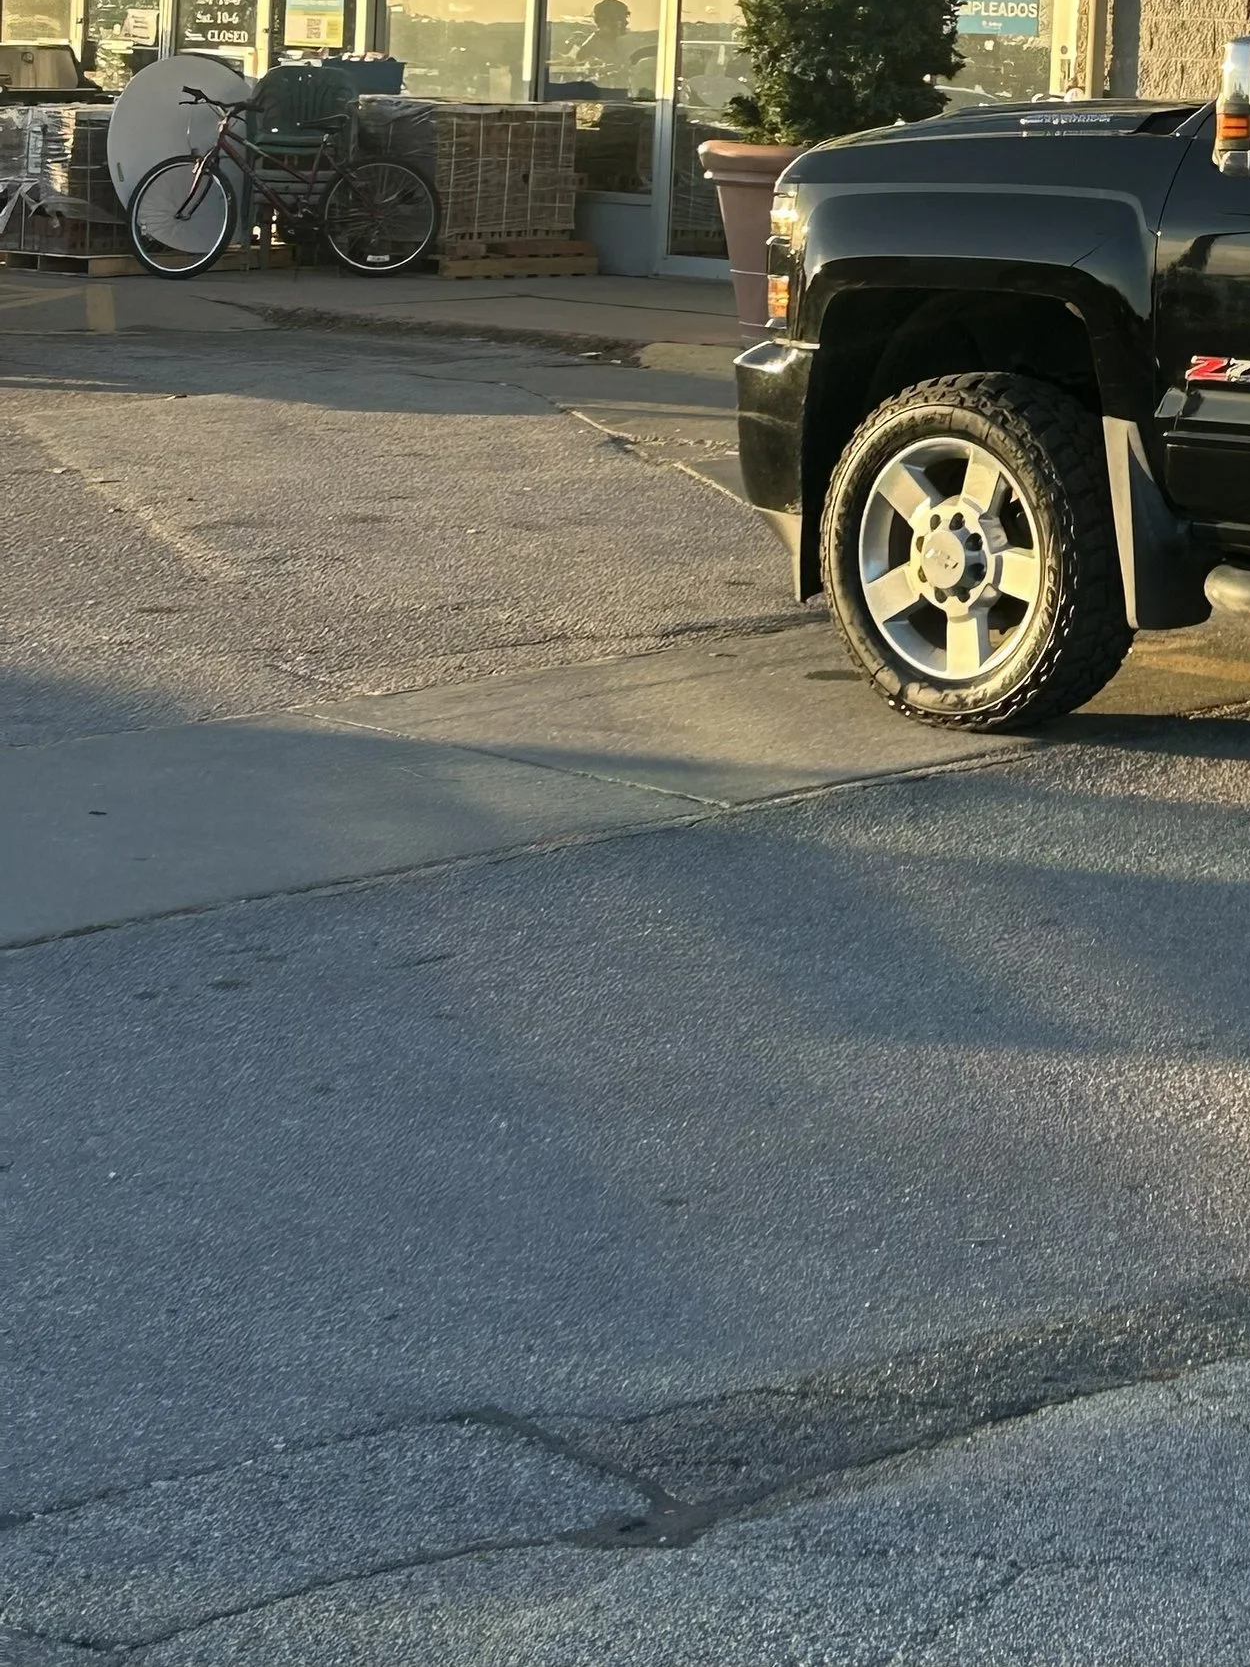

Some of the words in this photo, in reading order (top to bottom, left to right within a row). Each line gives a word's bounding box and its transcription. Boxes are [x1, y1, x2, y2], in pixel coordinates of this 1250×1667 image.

[957, 0, 1038, 18] PLEADOS
[217, 12, 239, 24] 10-6
[207, 30, 249, 42] CLOSED
